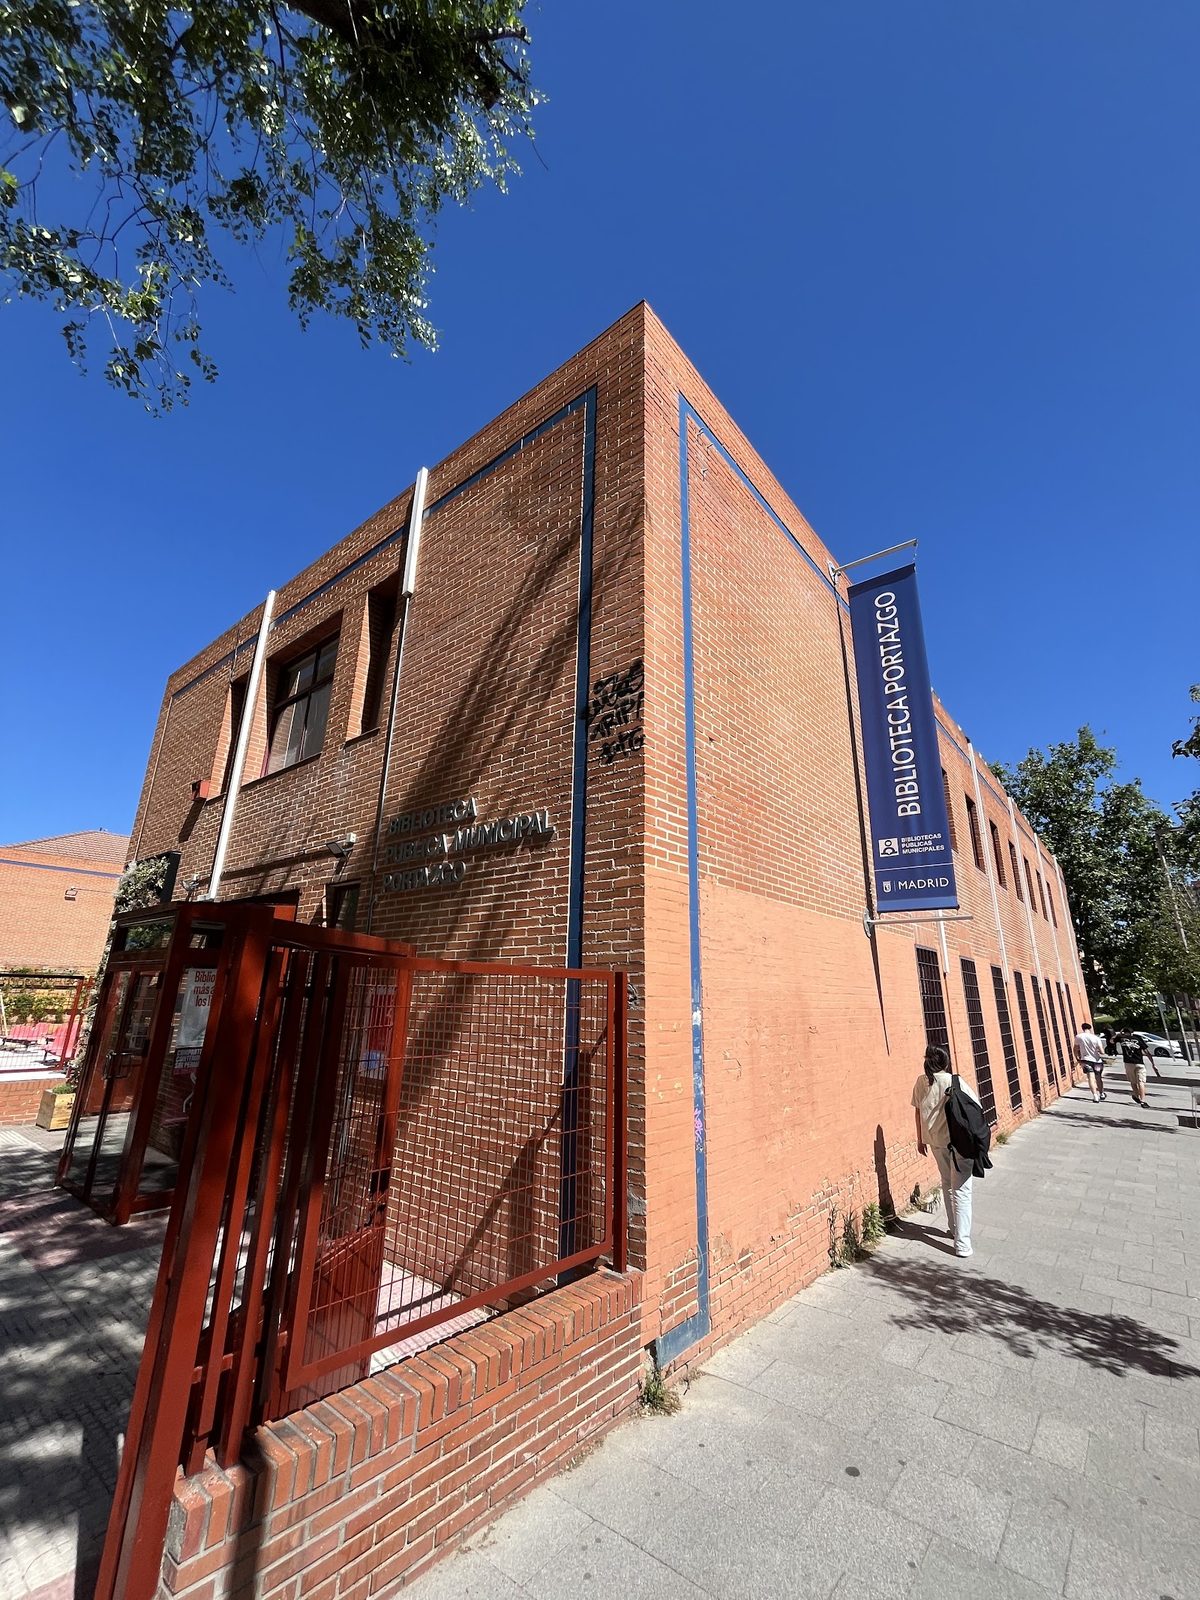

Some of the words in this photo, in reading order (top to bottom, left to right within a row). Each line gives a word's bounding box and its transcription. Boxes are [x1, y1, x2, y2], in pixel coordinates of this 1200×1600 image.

[874, 591, 907, 694] PORTAZGO
[886, 695, 921, 817] BIBLIOTECA
[388, 797, 478, 835] BIBLIOTECA
[454, 810, 556, 851] MUNICIPAL
[901, 833, 942, 843] BIBLIOTECAS
[902, 845, 945, 854] MUNICIPALES
[382, 861, 466, 893] PORTAZGO
[898, 877, 949, 890] MADRID
